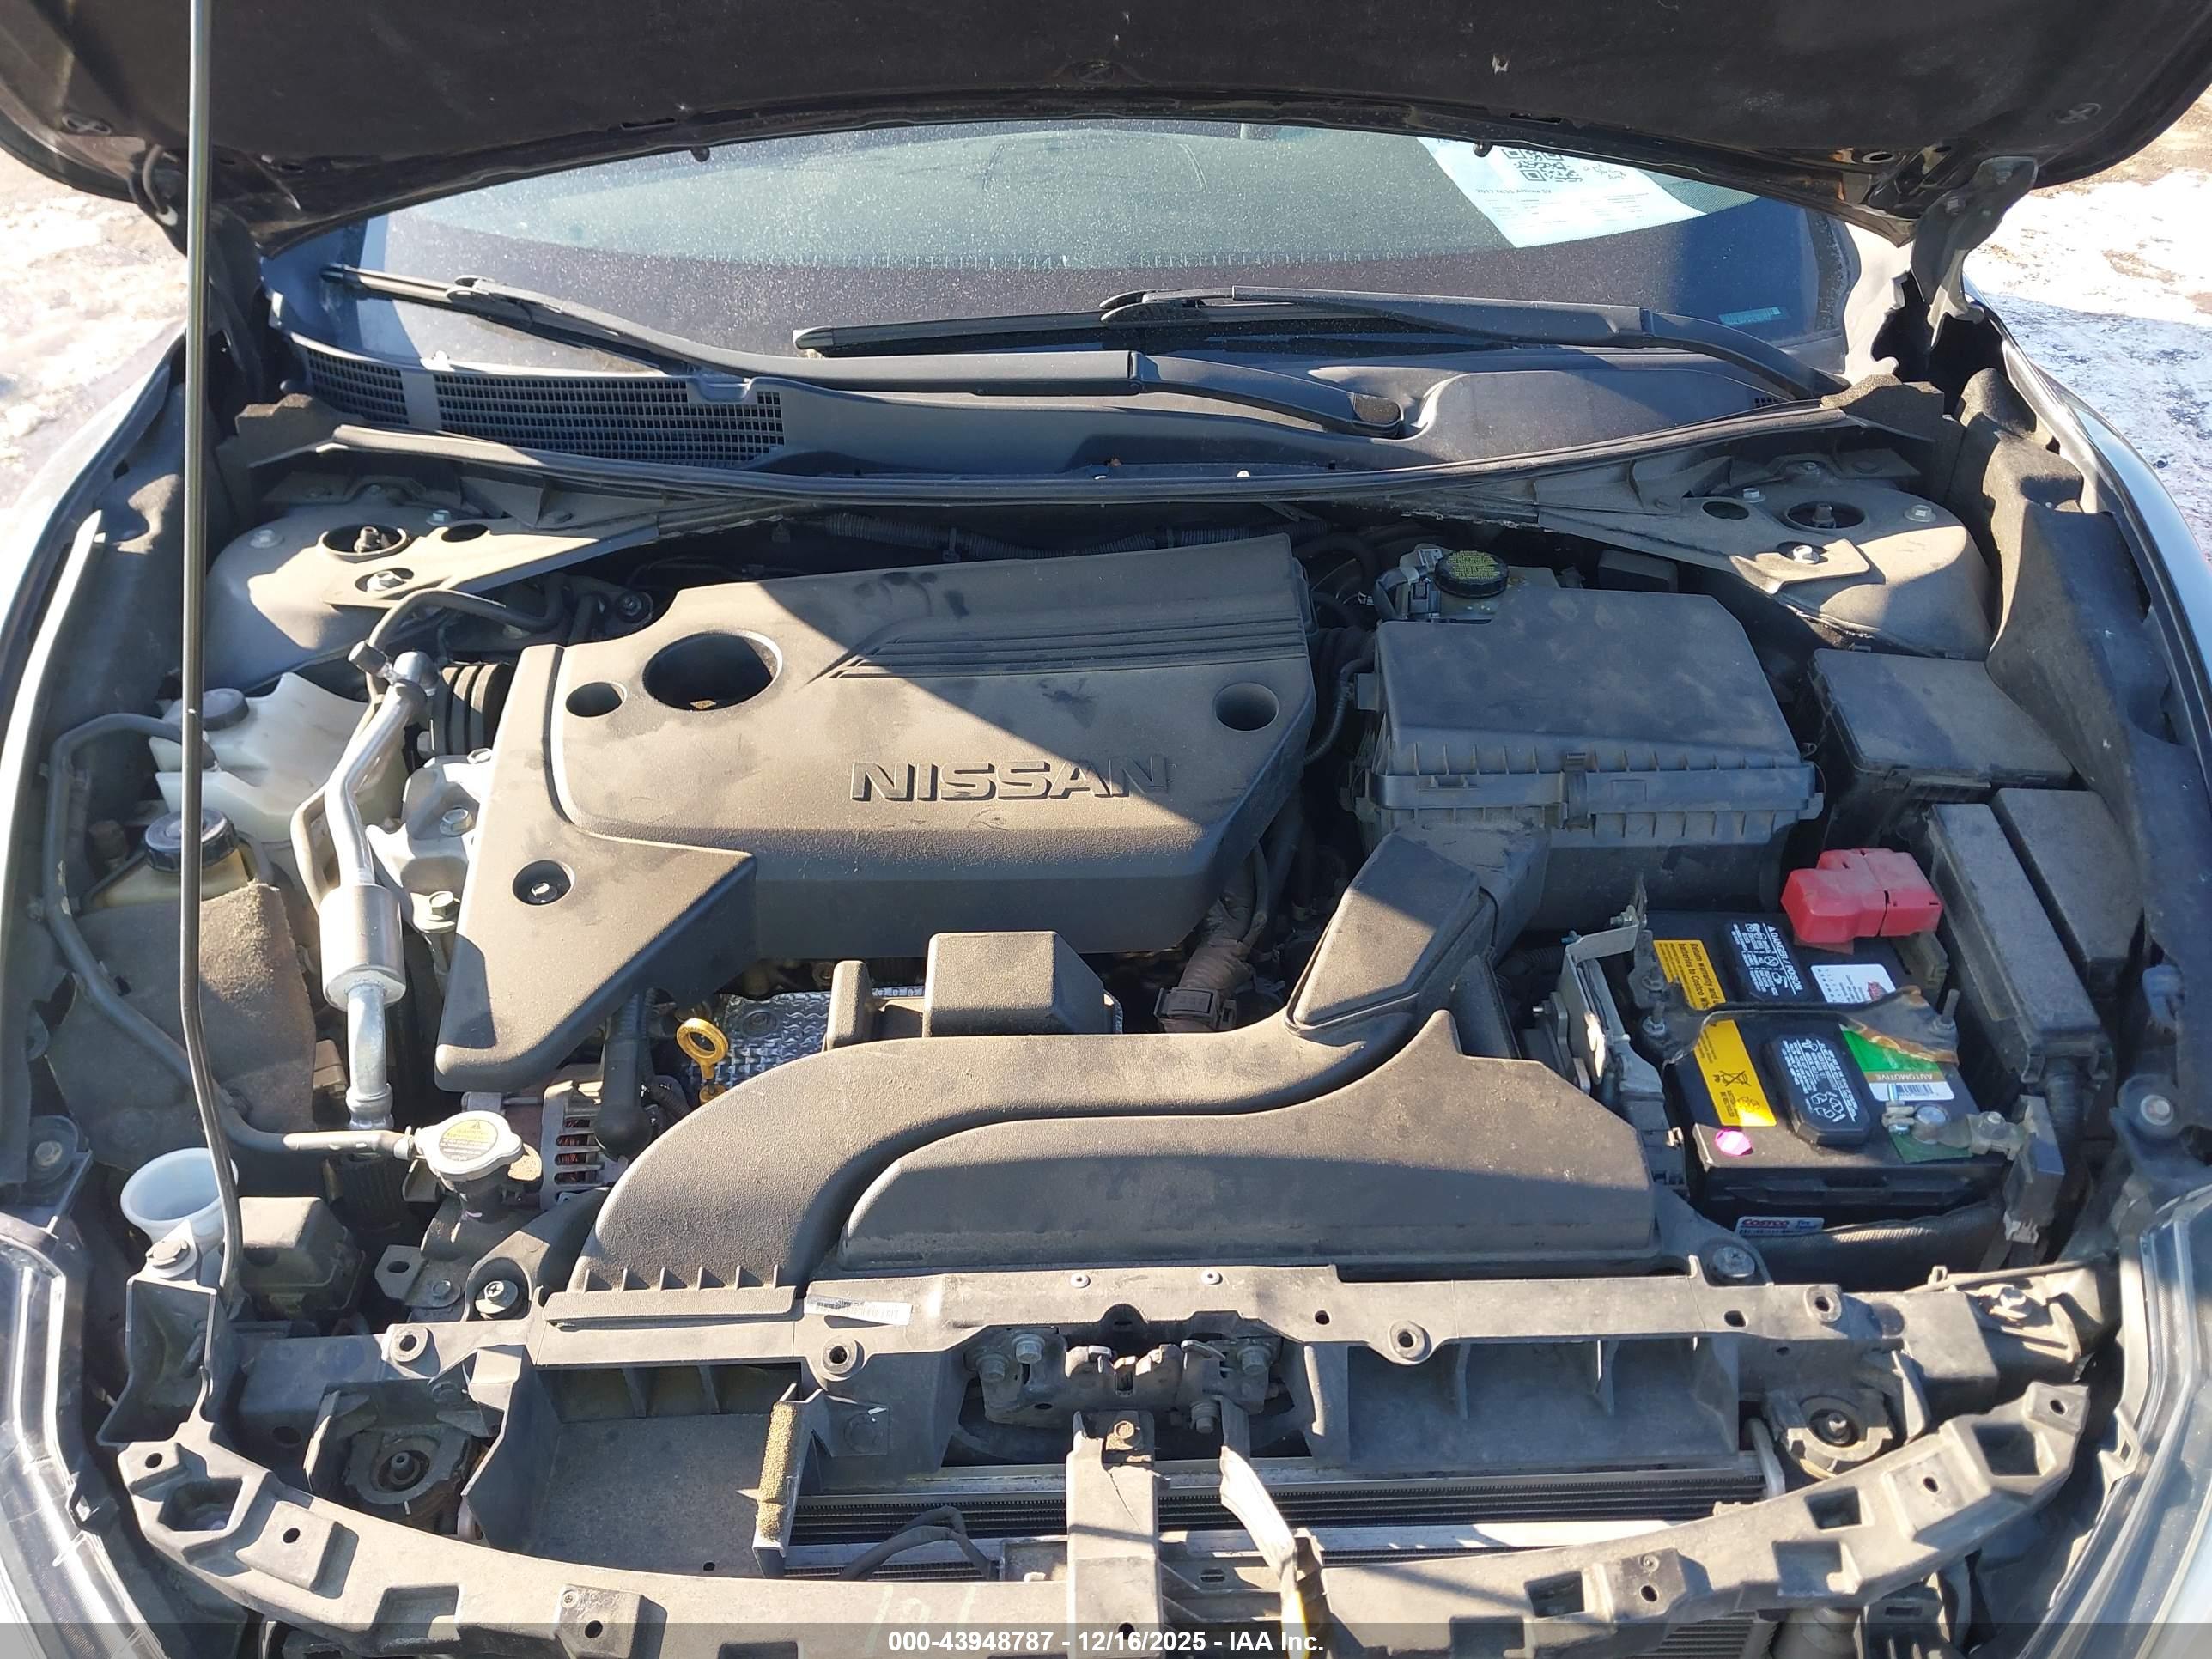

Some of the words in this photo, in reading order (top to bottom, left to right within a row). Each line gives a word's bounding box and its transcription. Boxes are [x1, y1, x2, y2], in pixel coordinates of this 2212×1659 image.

[850, 756, 1169, 802] NISSAN
[1677, 943, 1693, 968] batteries
[1691, 975, 1705, 996] Costco
[1689, 943, 1703, 962] Return
[1698, 963, 1713, 987] warranty
[1770, 932, 1789, 960] DANGER
[1785, 964, 1803, 990] POISON
